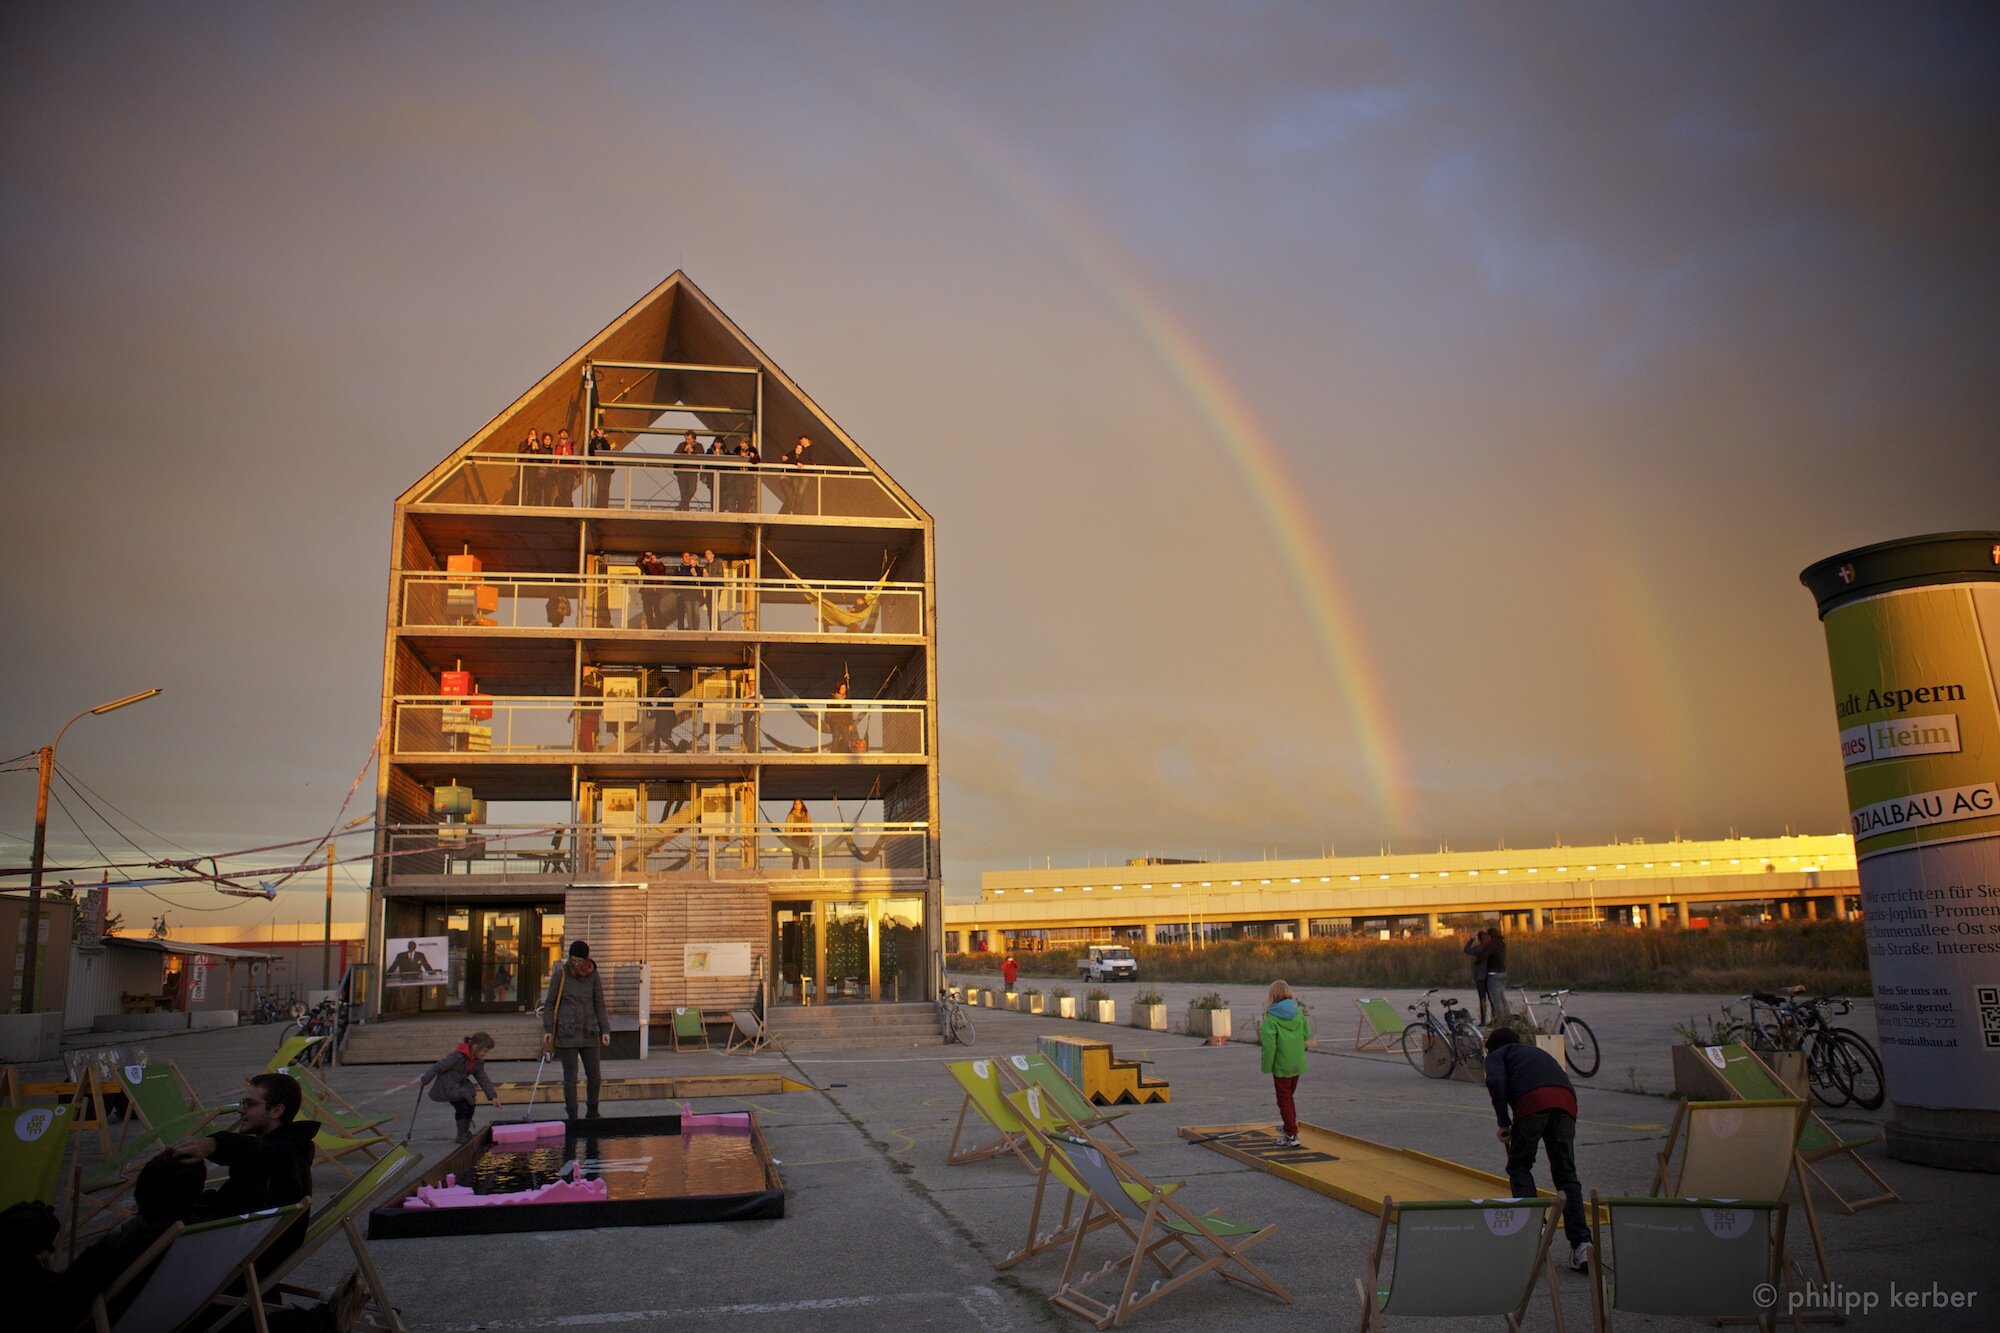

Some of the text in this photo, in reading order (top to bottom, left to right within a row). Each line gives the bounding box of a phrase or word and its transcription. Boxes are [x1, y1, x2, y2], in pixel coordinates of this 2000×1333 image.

[1865, 684, 1966, 712] Aspern
[1875, 724, 1952, 750] Heim
[1852, 789, 1994, 836] OZIALBAU AG
[1881, 888, 1945, 902] errichten
[1950, 885, 1973, 899] für
[1895, 985, 1909, 995] Sie
[1911, 987, 1930, 995] uns
[1932, 987, 1951, 996] an.
[1900, 1002, 1914, 1011] Sie
[1916, 1002, 1953, 1014] gerne!
